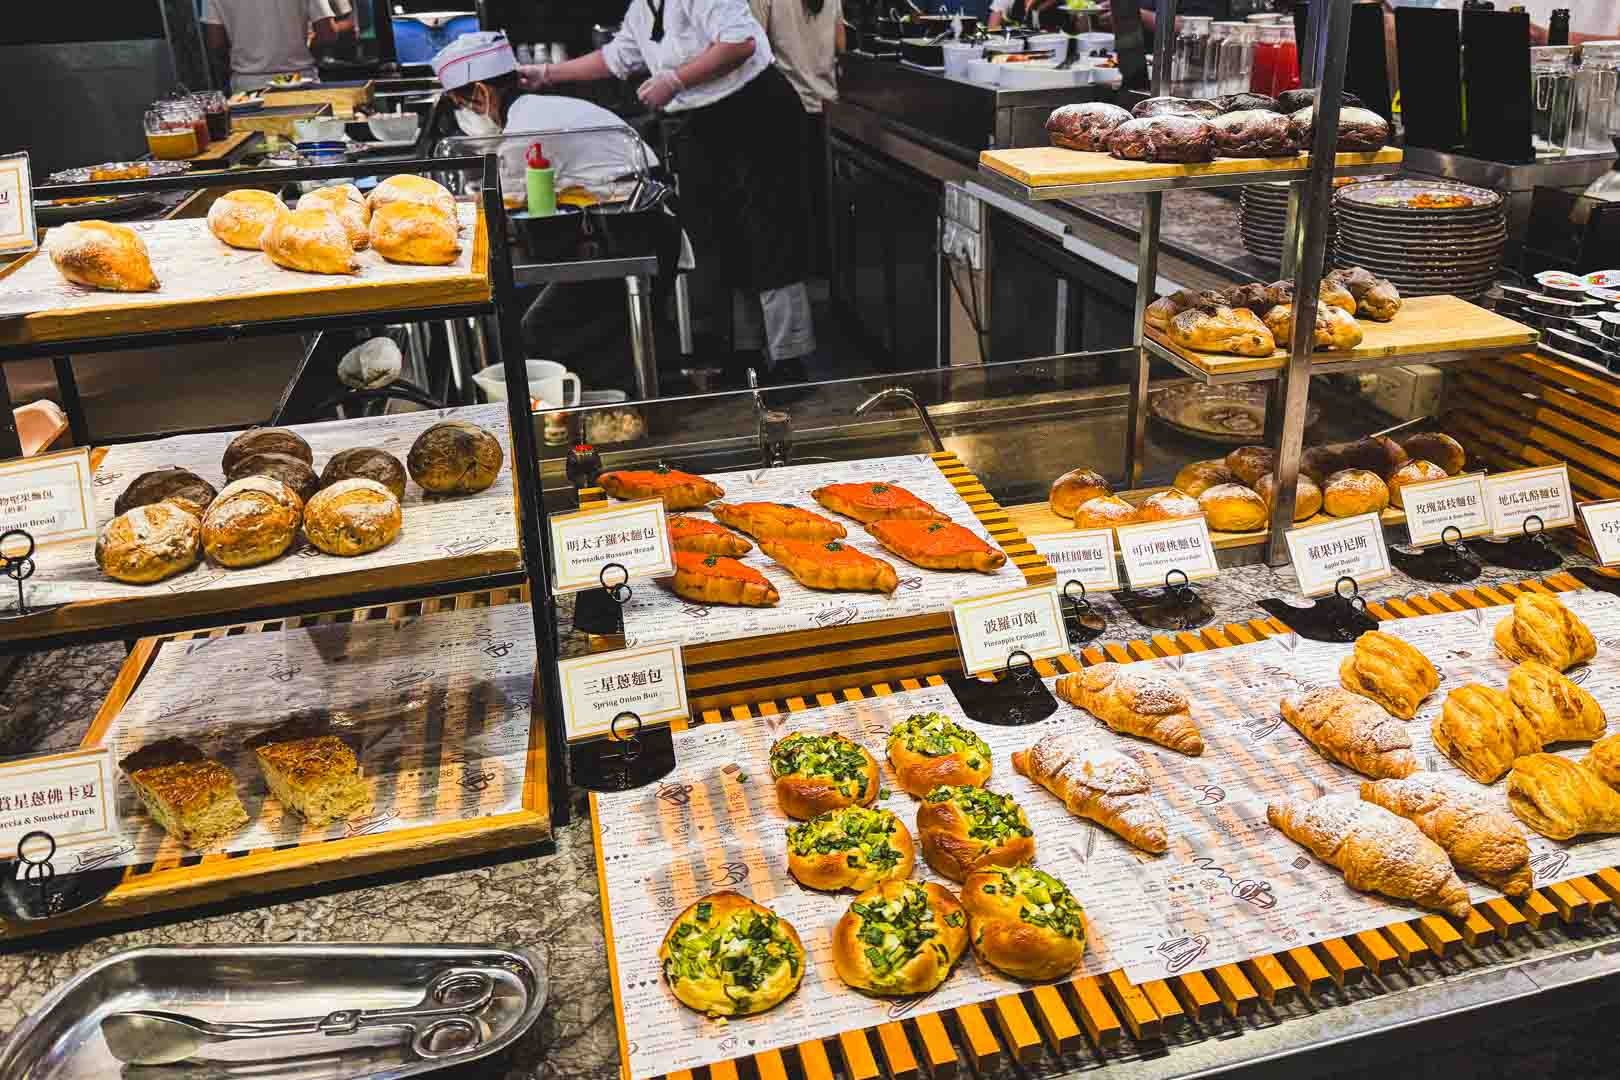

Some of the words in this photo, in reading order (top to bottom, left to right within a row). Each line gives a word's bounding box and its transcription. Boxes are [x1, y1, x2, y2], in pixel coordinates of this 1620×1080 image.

[566, 527, 657, 552] 明太子羅宋麵包
[1132, 536, 1201, 557] 可可櫻桃麵包
[1308, 535, 1368, 560] 蘋果丹尼斯
[983, 609, 1039, 635] 波羅可頌
[592, 699, 619, 711] Spring
[619, 694, 642, 705] Onion
[643, 690, 659, 700] Bun
[33, 811, 70, 825] Smoked
[71, 806, 96, 818] Duck
